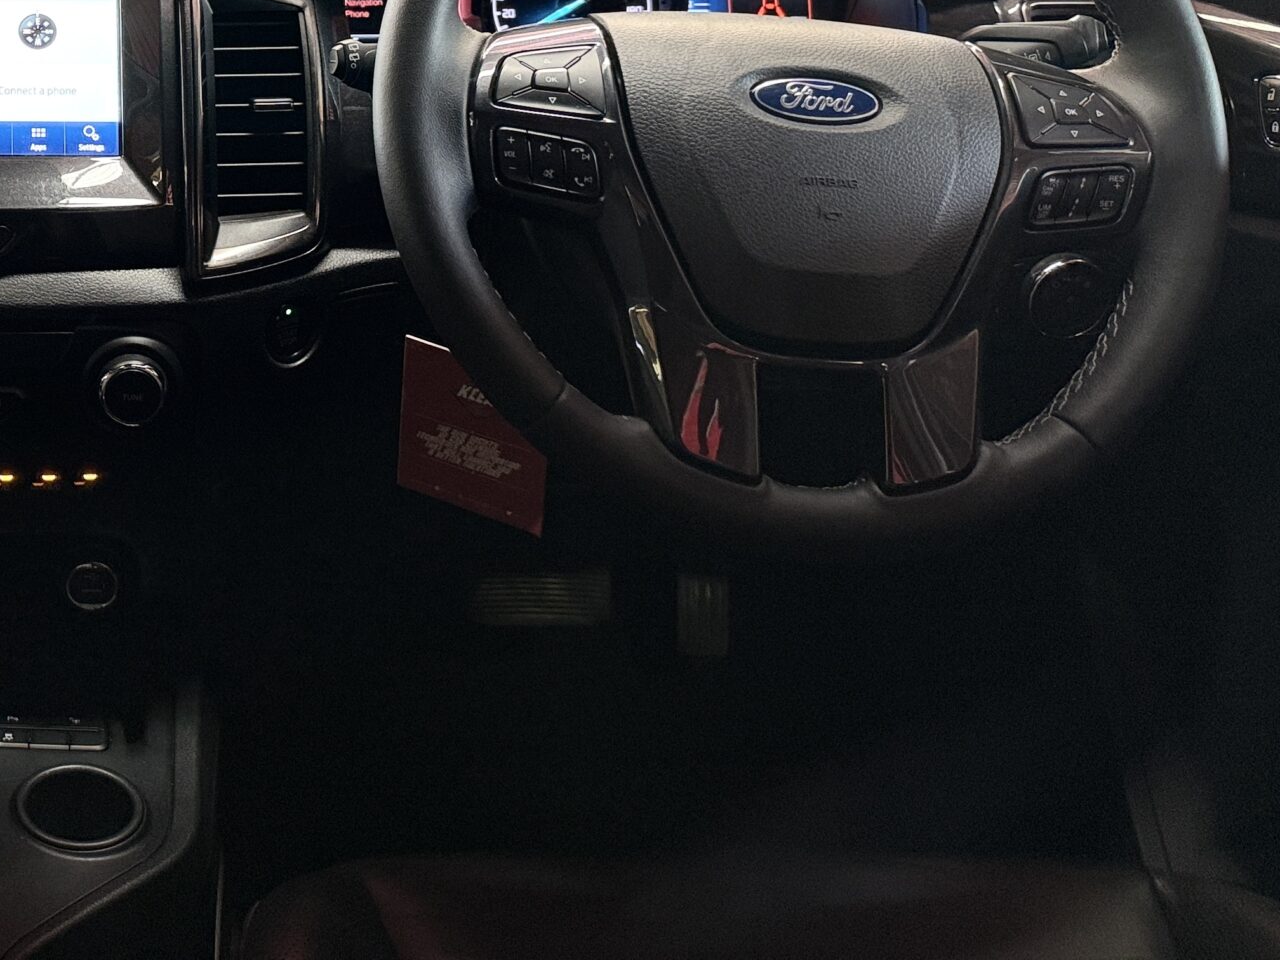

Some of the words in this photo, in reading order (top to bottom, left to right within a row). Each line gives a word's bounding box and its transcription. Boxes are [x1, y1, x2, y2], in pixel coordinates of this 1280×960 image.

[344, 0, 384, 8] Navigation
[344, 10, 370, 18] Phone
[502, 8, 516, 19] 20
[38, 88, 46, 96] a
[47, 85, 78, 97] phone
[780, 81, 854, 114] Ford
[1065, 108, 1078, 116] OK
[29, 142, 47, 152] Apps
[77, 142, 105, 152] Settings
[503, 150, 516, 158] VOL
[1108, 174, 1125, 183] RES
[1099, 200, 1114, 208] SET
